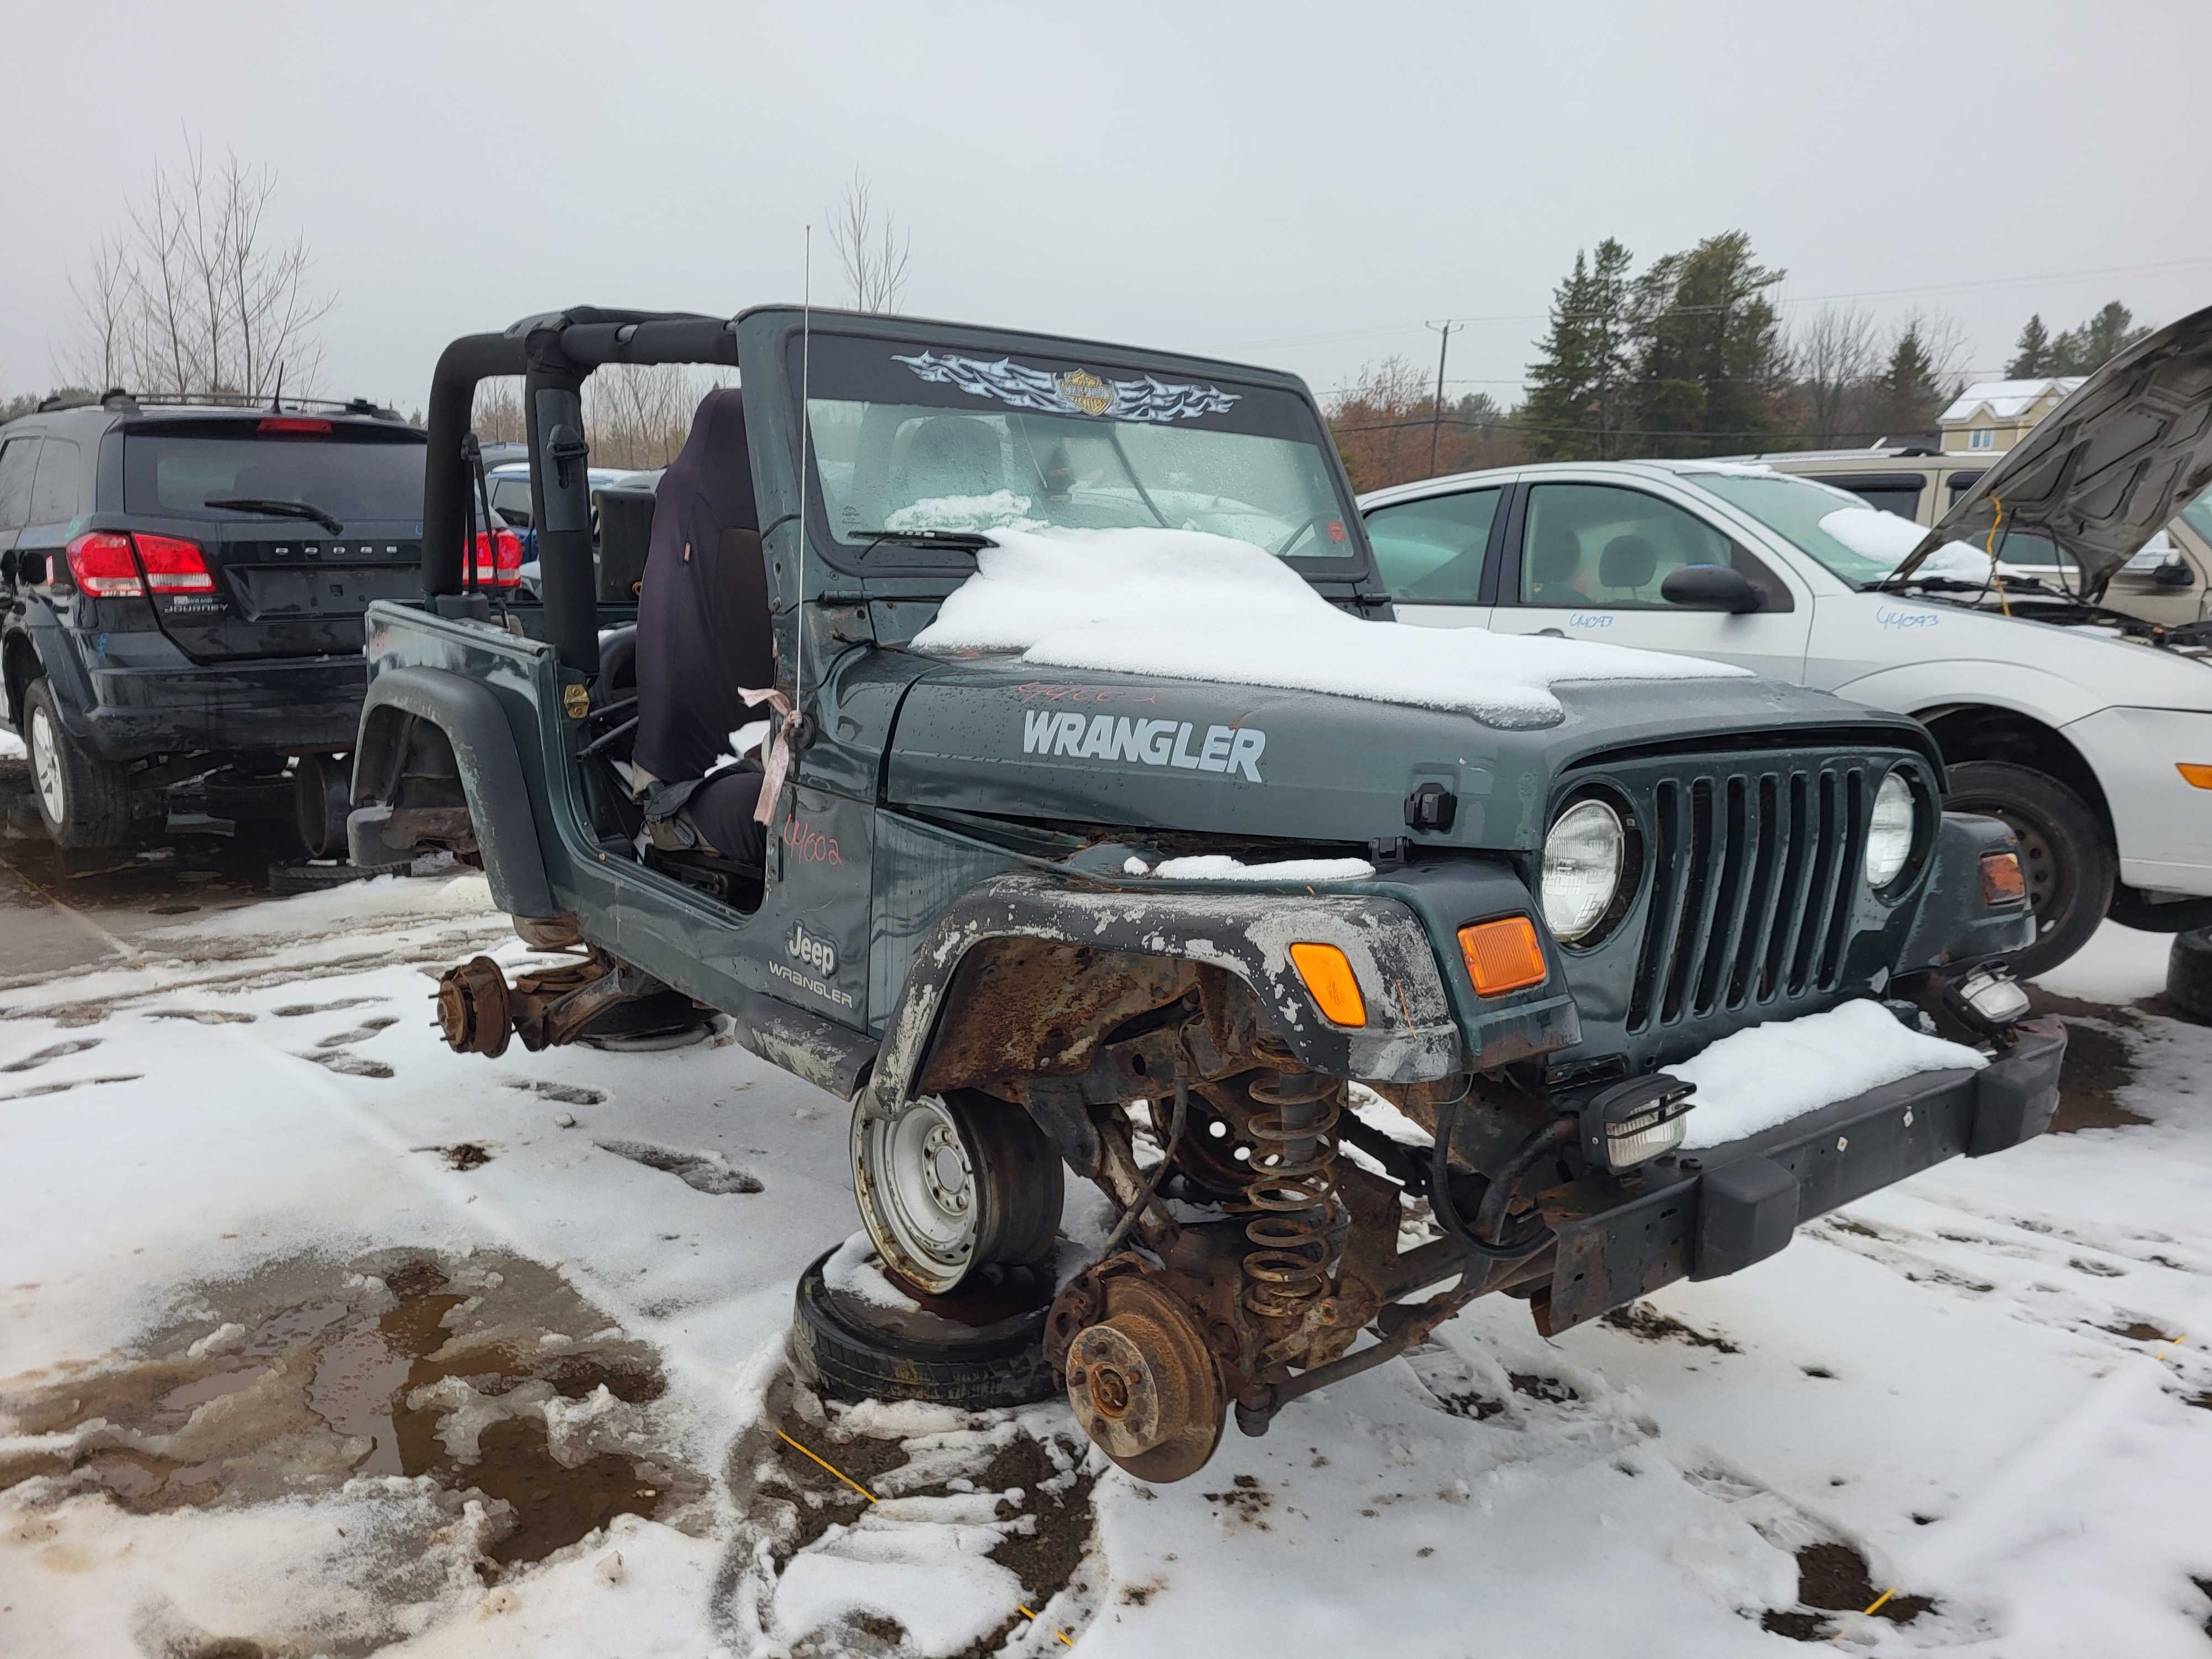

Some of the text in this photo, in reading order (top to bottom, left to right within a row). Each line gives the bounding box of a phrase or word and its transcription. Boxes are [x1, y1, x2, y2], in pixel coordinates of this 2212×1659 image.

[164, 603, 228, 613] JOURNEY
[1875, 606, 1938, 629] 44093
[1023, 709, 1266, 784] WRANGLER
[789, 926, 834, 975] Jeep
[768, 960, 853, 1009] WRANGLER
